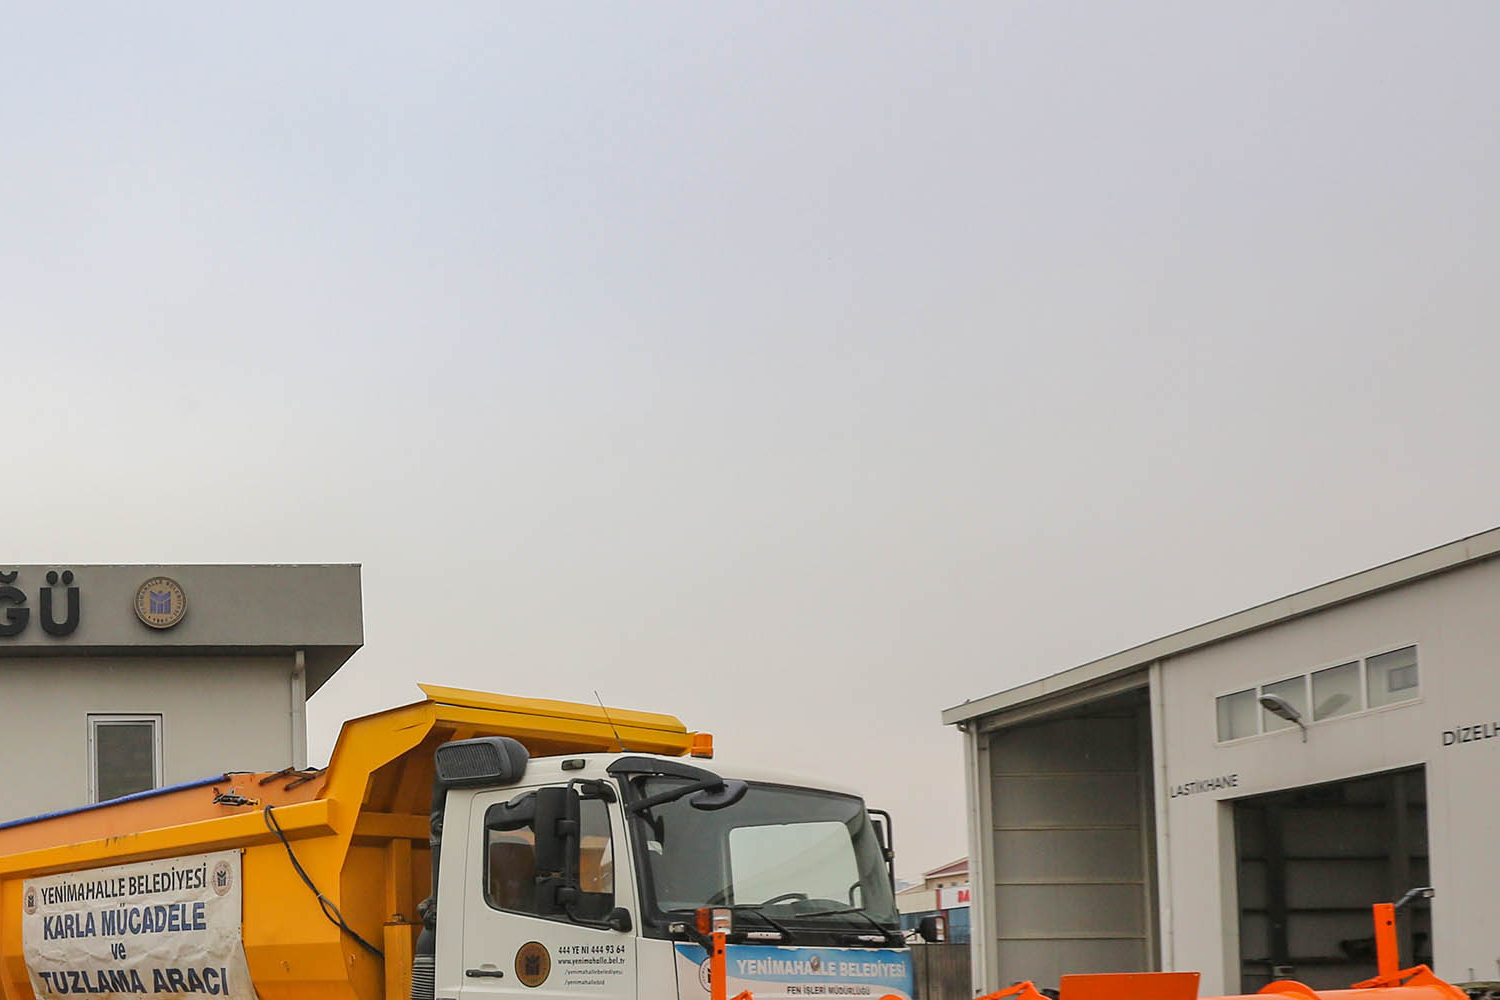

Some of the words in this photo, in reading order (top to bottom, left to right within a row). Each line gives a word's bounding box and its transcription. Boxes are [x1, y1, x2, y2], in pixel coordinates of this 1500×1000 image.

[41, 879, 125, 905] YENİMAHALLE
[128, 863, 207, 897] BELEDİYESİ
[43, 911, 97, 941] KARLA
[101, 902, 207, 937] MÜCADELE
[111, 942, 127, 961] ve
[558, 946, 570, 954] 444
[571, 945, 580, 954] YE
[591, 945, 604, 954] 444
[605, 945, 615, 954] 93
[616, 944, 625, 954] 64
[736, 957, 837, 976] YENİMAHALE
[840, 960, 907, 977] BELEDİYESİ
[38, 969, 147, 994] TUZLAMA
[153, 967, 229, 995] ARACI
[787, 986, 801, 994] FEN
